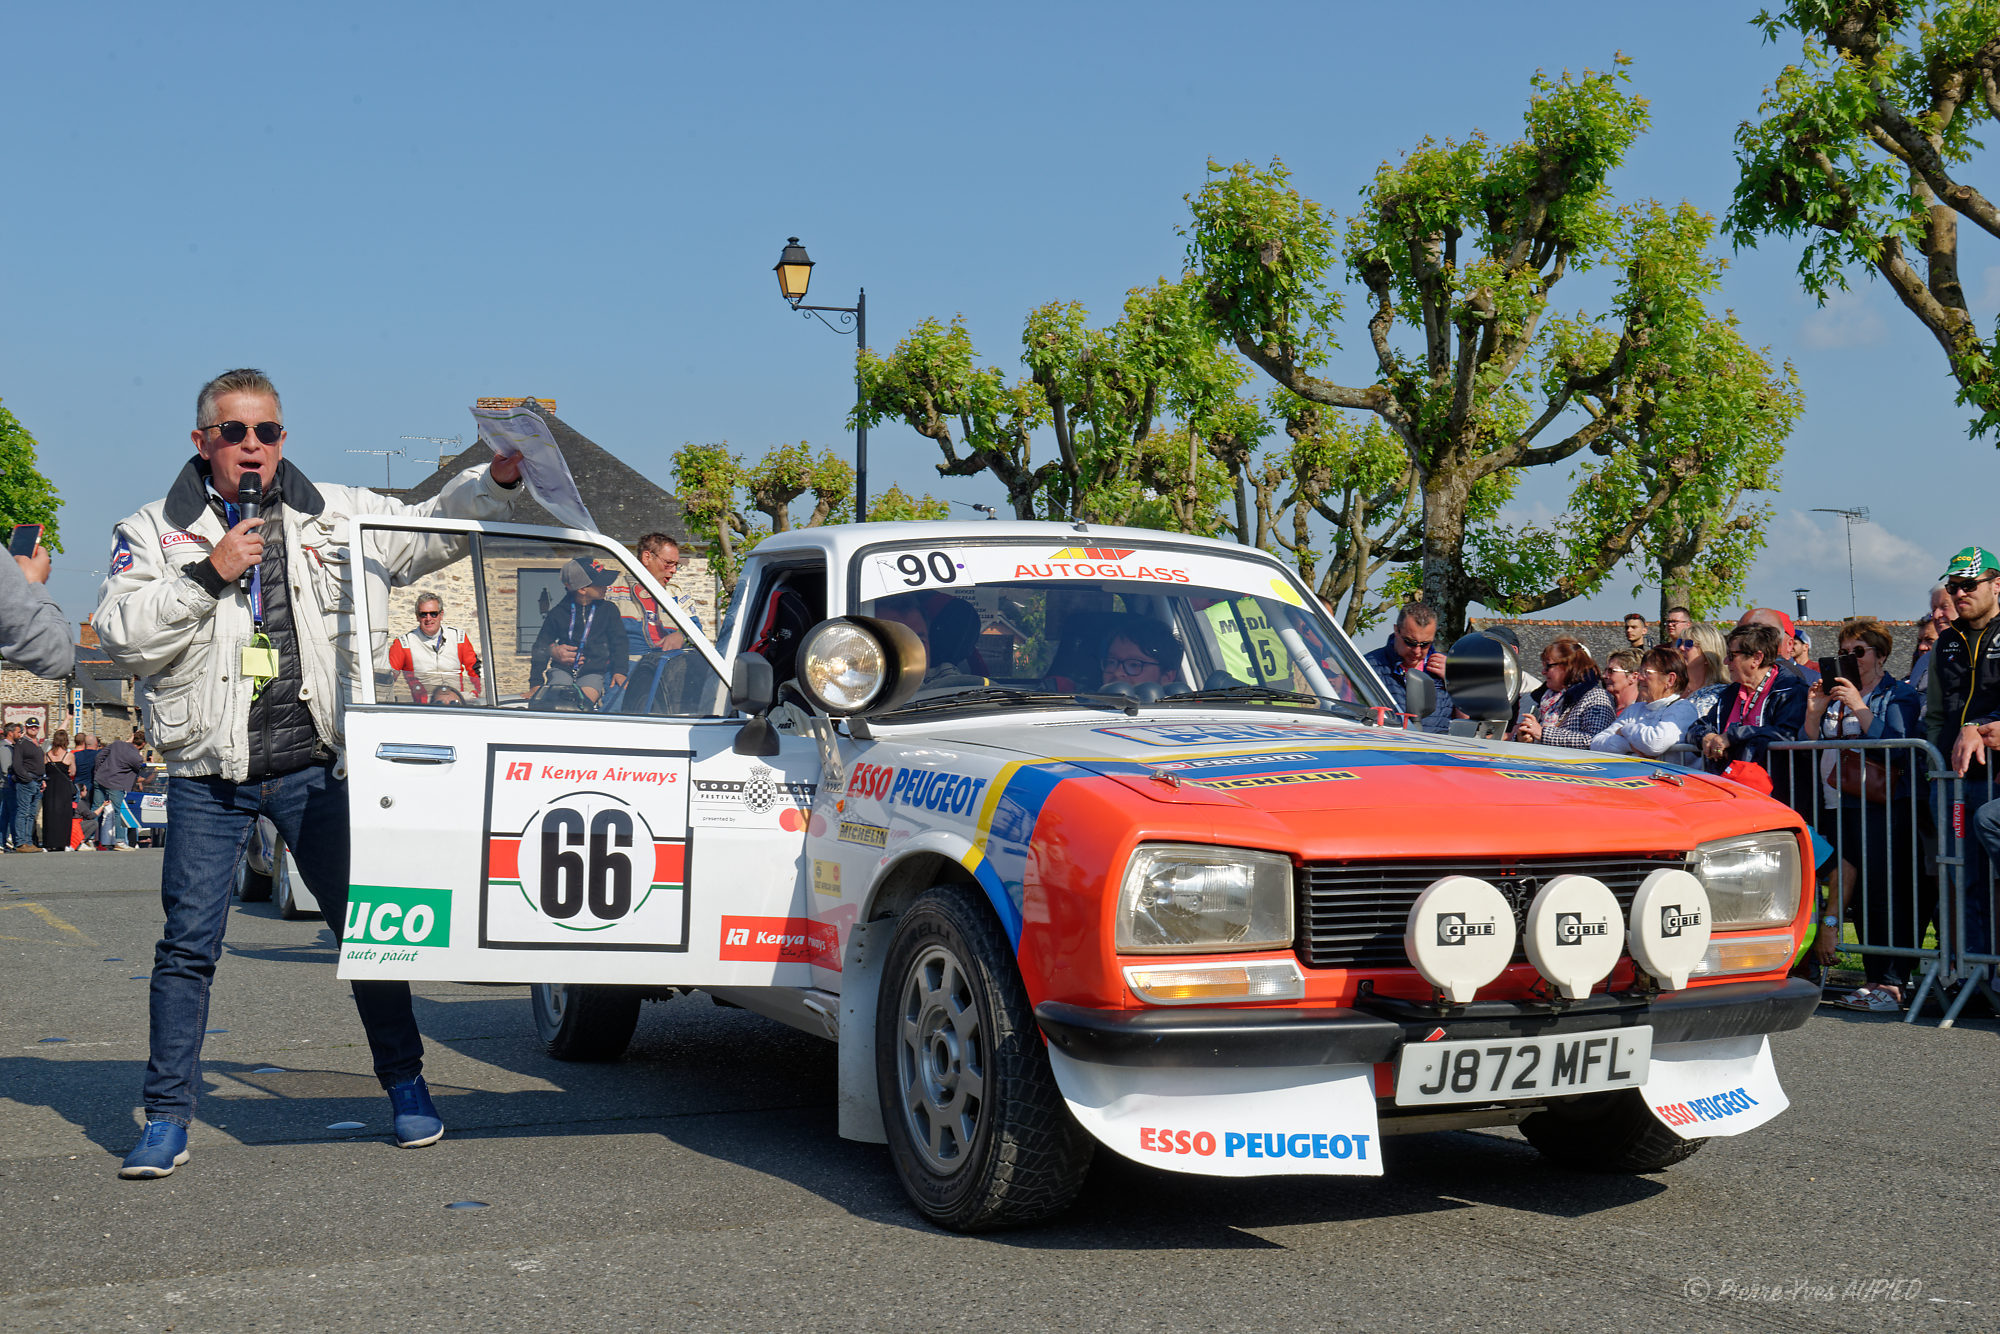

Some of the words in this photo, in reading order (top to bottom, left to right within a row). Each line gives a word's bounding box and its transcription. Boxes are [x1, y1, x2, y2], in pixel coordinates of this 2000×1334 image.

[163, 533, 205, 545] Canon
[897, 551, 957, 587] 90
[1014, 563, 1190, 583] AUTOGLASS
[1219, 616, 1272, 635] MDI
[1191, 753, 1308, 767] FACOM
[541, 765, 598, 783] Kenya
[602, 767, 678, 786] Airways
[1502, 772, 1651, 788] MICHELIN
[699, 782, 741, 790] GOOD
[846, 763, 893, 802] ESSO
[888, 768, 988, 817] PEUGEOT
[701, 794, 742, 802] FESTIVAL
[840, 824, 888, 845] MICHELIN
[540, 808, 634, 921] 66
[756, 932, 805, 948] Kenya
[346, 948, 377, 961] auto
[379, 948, 419, 965] paint
[1419, 1045, 1541, 1095] J872
[1551, 1036, 1631, 1087] MFL
[1656, 1102, 1699, 1127] ESSO
[1686, 1087, 1760, 1122] PEUGEOT
[1140, 1127, 1217, 1157] ESSO
[1224, 1131, 1370, 1161] PEUGEOT
